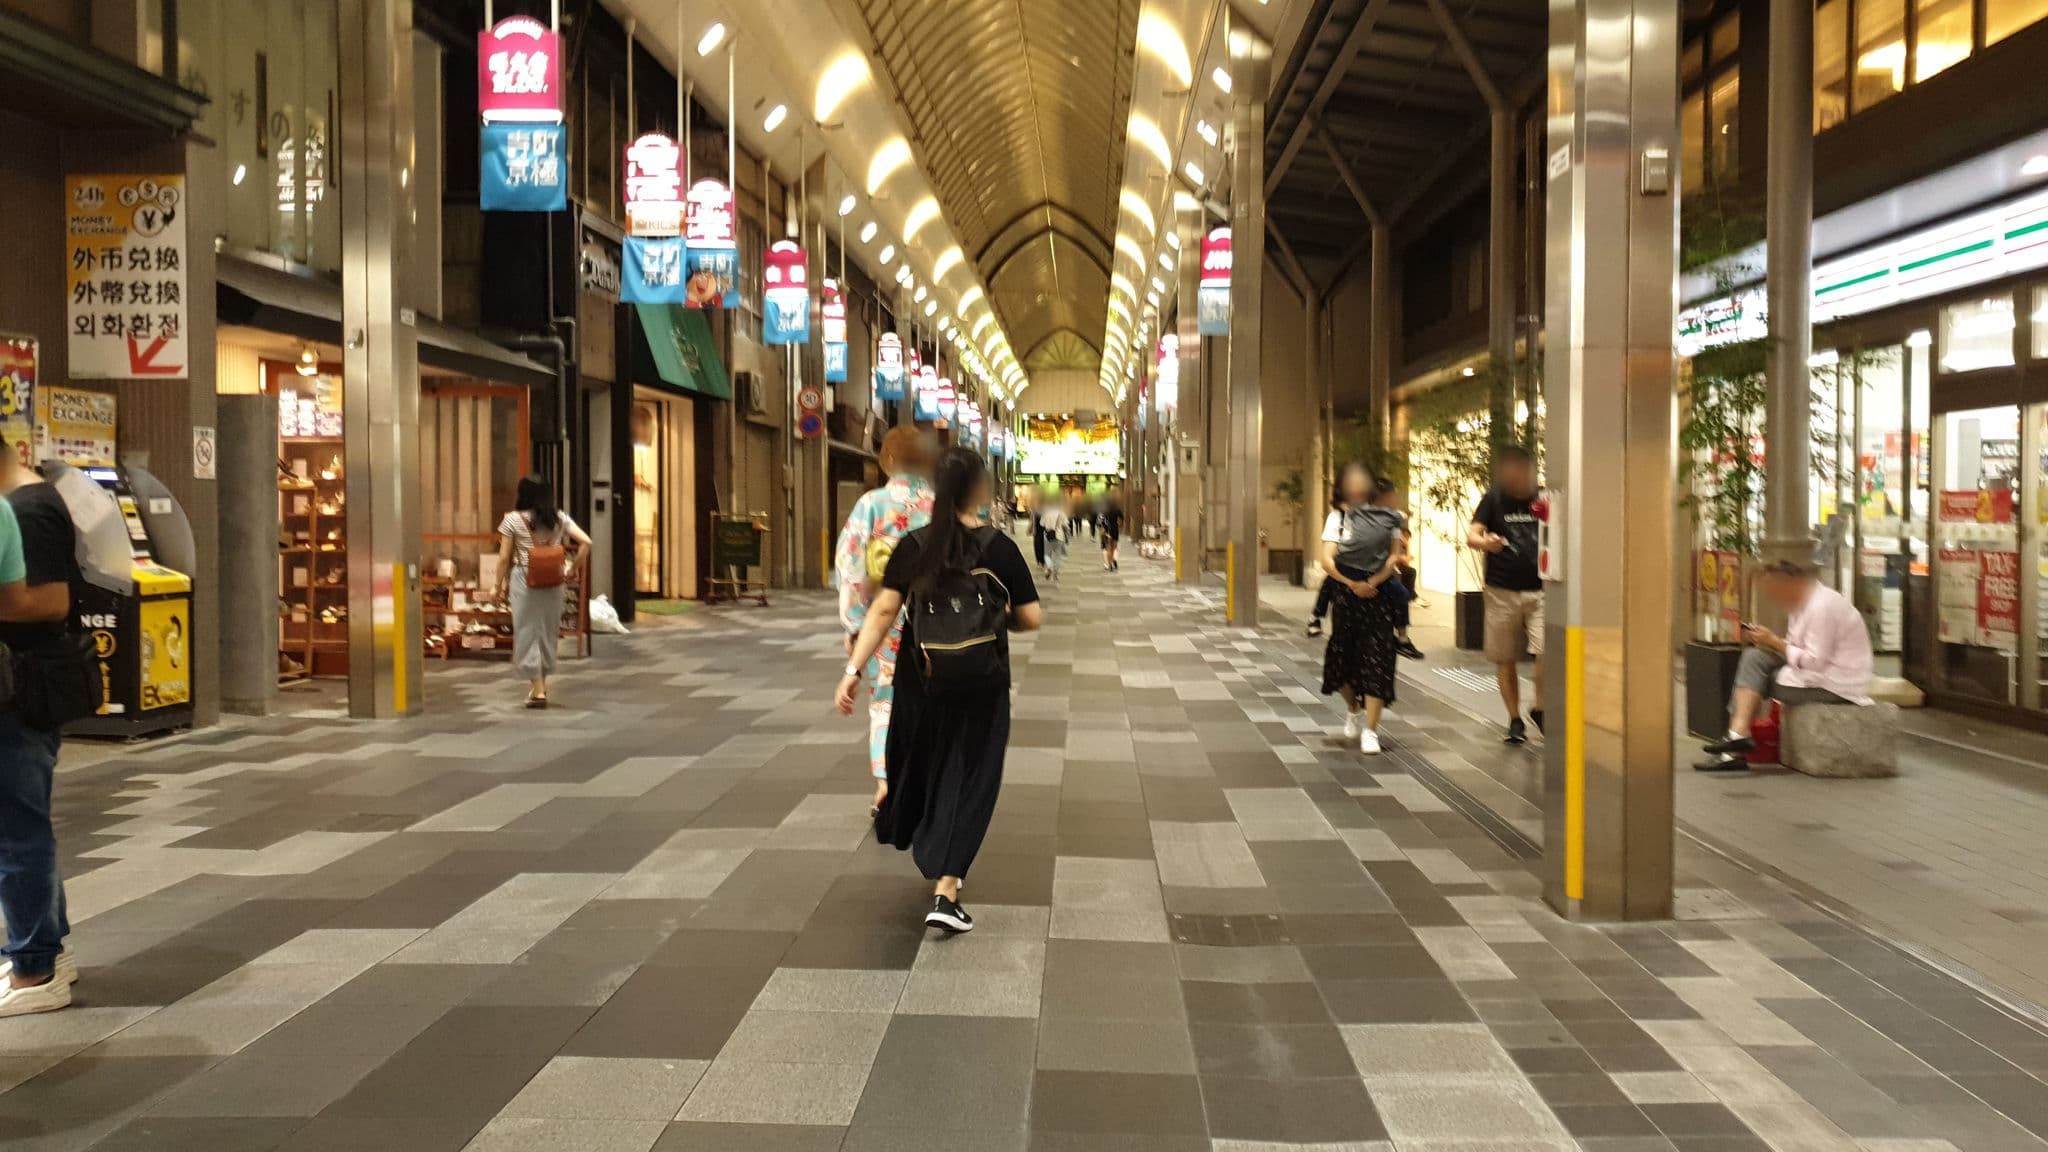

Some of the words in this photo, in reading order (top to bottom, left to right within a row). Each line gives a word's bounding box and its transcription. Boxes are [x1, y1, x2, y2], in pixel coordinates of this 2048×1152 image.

[504, 158, 559, 187] 京極
[73, 313, 180, 340] 외화환전
[53, 392, 90, 407] MONEY
[53, 407, 114, 426] EXCHANGE
